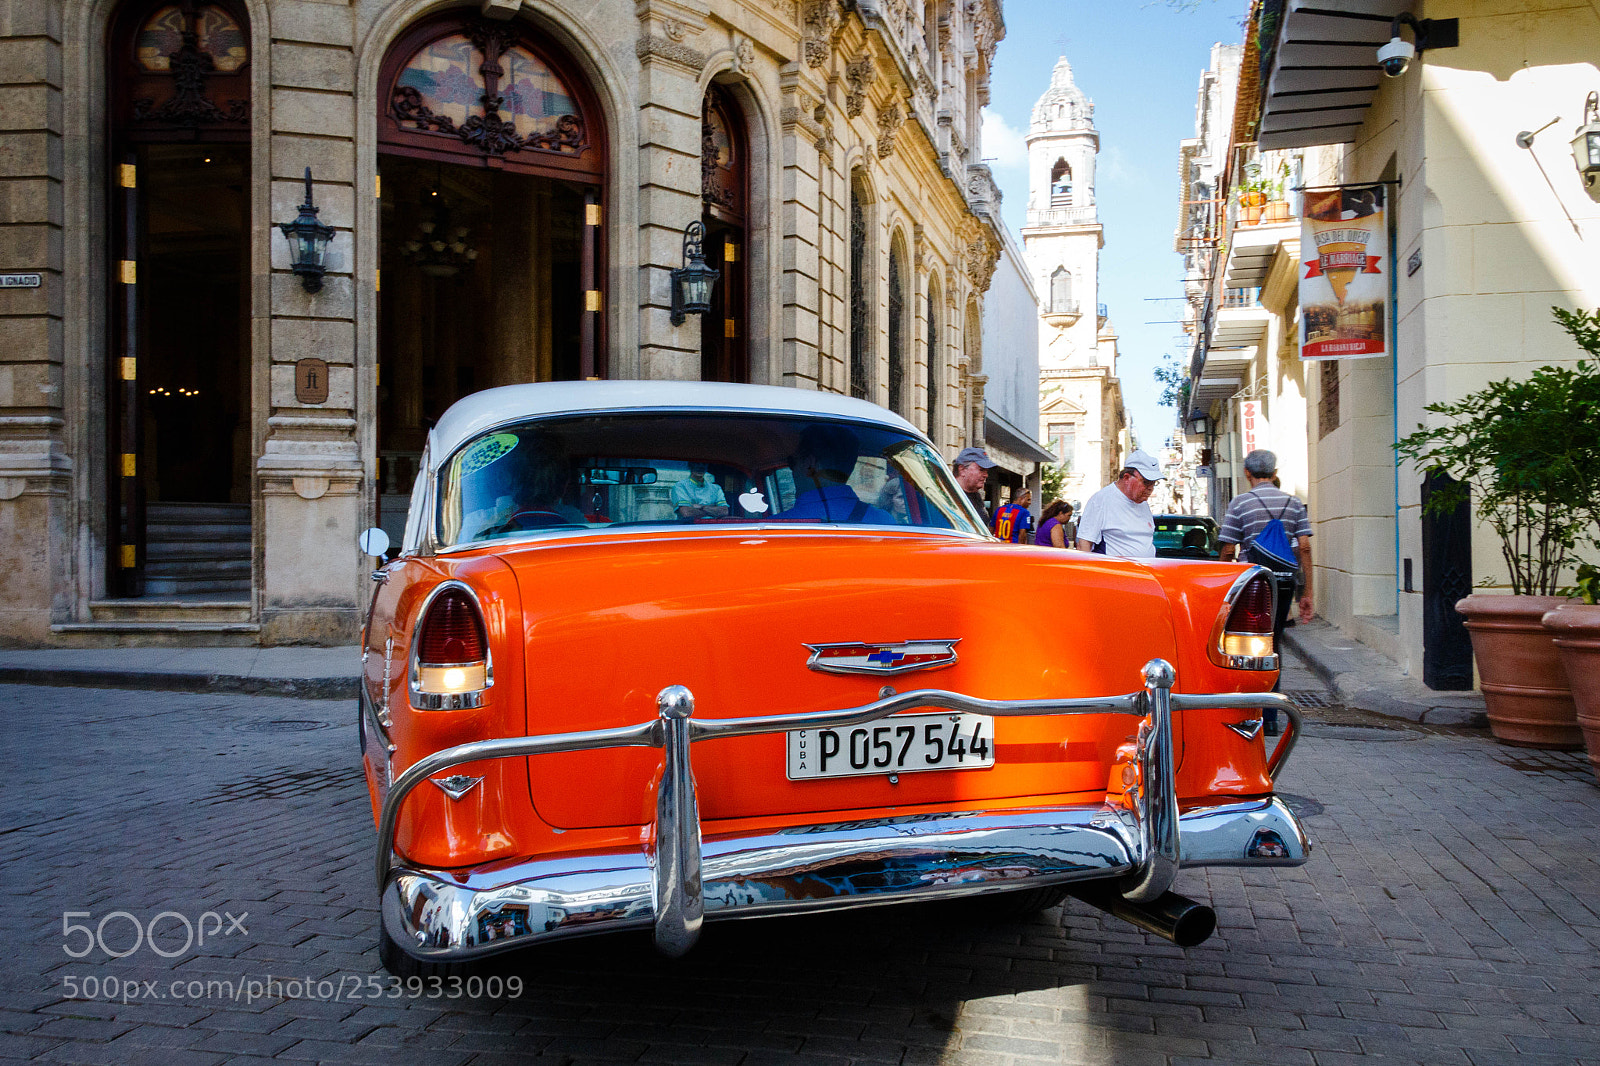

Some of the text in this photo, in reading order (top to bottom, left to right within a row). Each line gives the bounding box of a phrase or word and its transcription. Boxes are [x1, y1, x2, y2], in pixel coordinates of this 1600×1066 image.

[1314, 230, 1371, 246] CASA DEL QUESO
[5, 276, 38, 286] IGNACIO
[998, 519, 1011, 539] 10
[799, 730, 807, 770] CUBA
[819, 730, 840, 772] P
